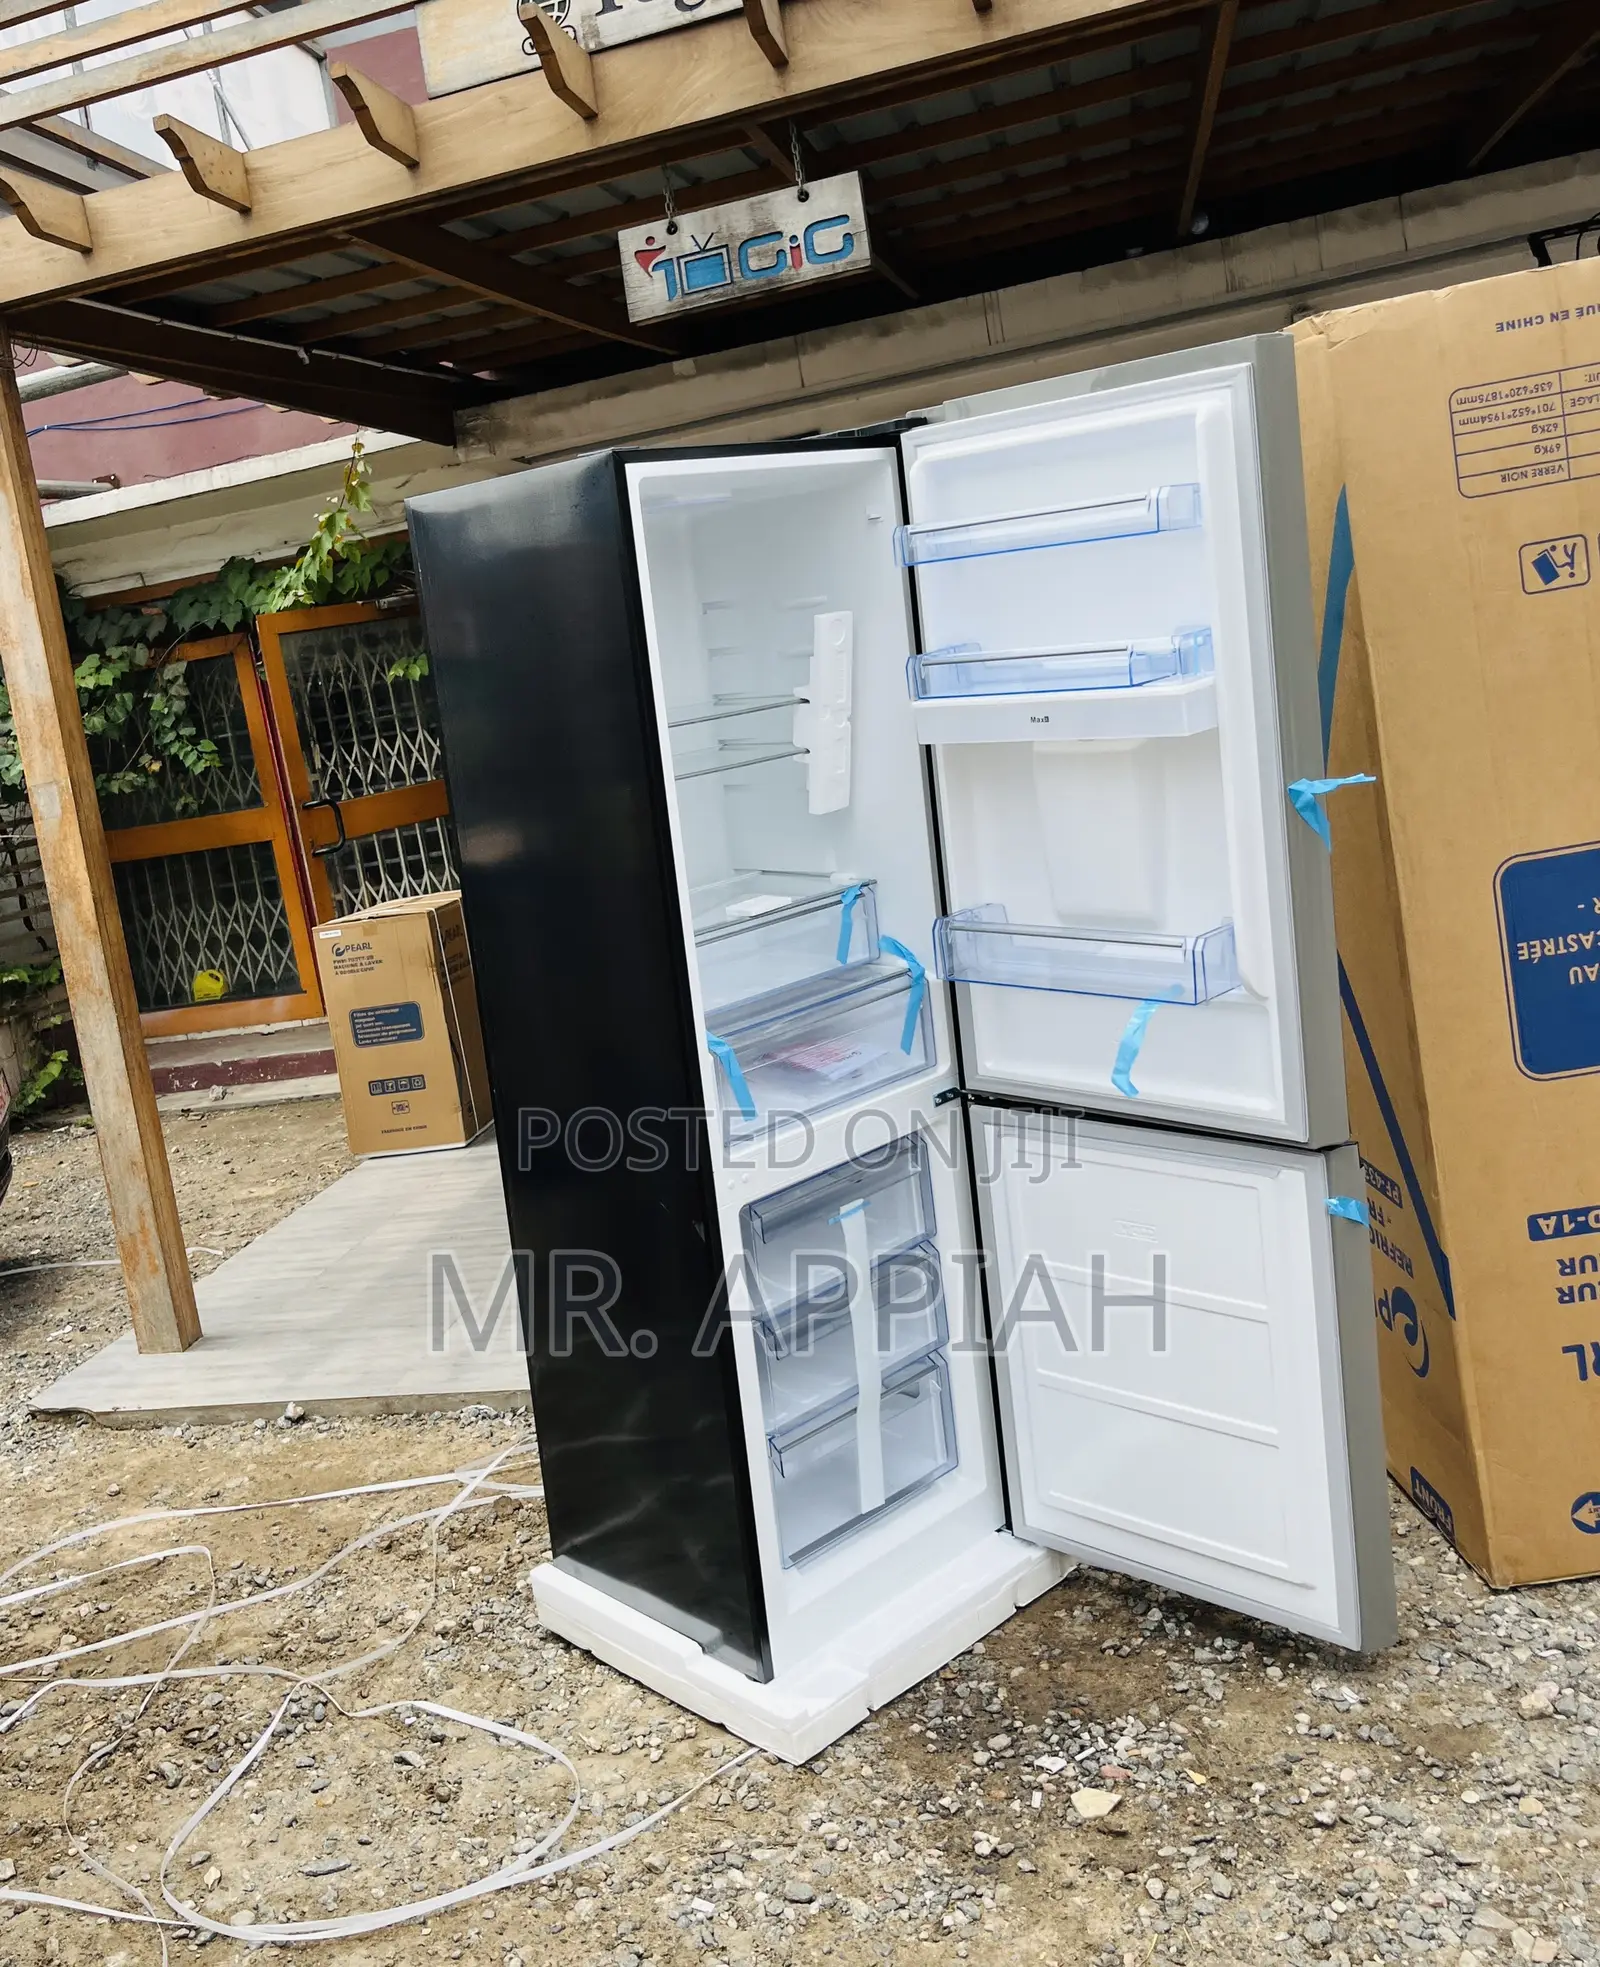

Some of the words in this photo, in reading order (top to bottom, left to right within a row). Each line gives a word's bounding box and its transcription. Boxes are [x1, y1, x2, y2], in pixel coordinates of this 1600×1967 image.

[1549, 309, 1570, 323] EN
[1495, 314, 1545, 333] CHINE
[1570, 393, 1600, 408] LAGE
[1531, 422, 1559, 434] 62Kg
[1533, 443, 1561, 455] 69Kg
[1500, 470, 1528, 483] NOIR
[1531, 464, 1565, 479] VERRE
[345, 942, 373, 953] PEARL
[1556, 1253, 1600, 1277] UR
[1555, 1281, 1600, 1305] UR
